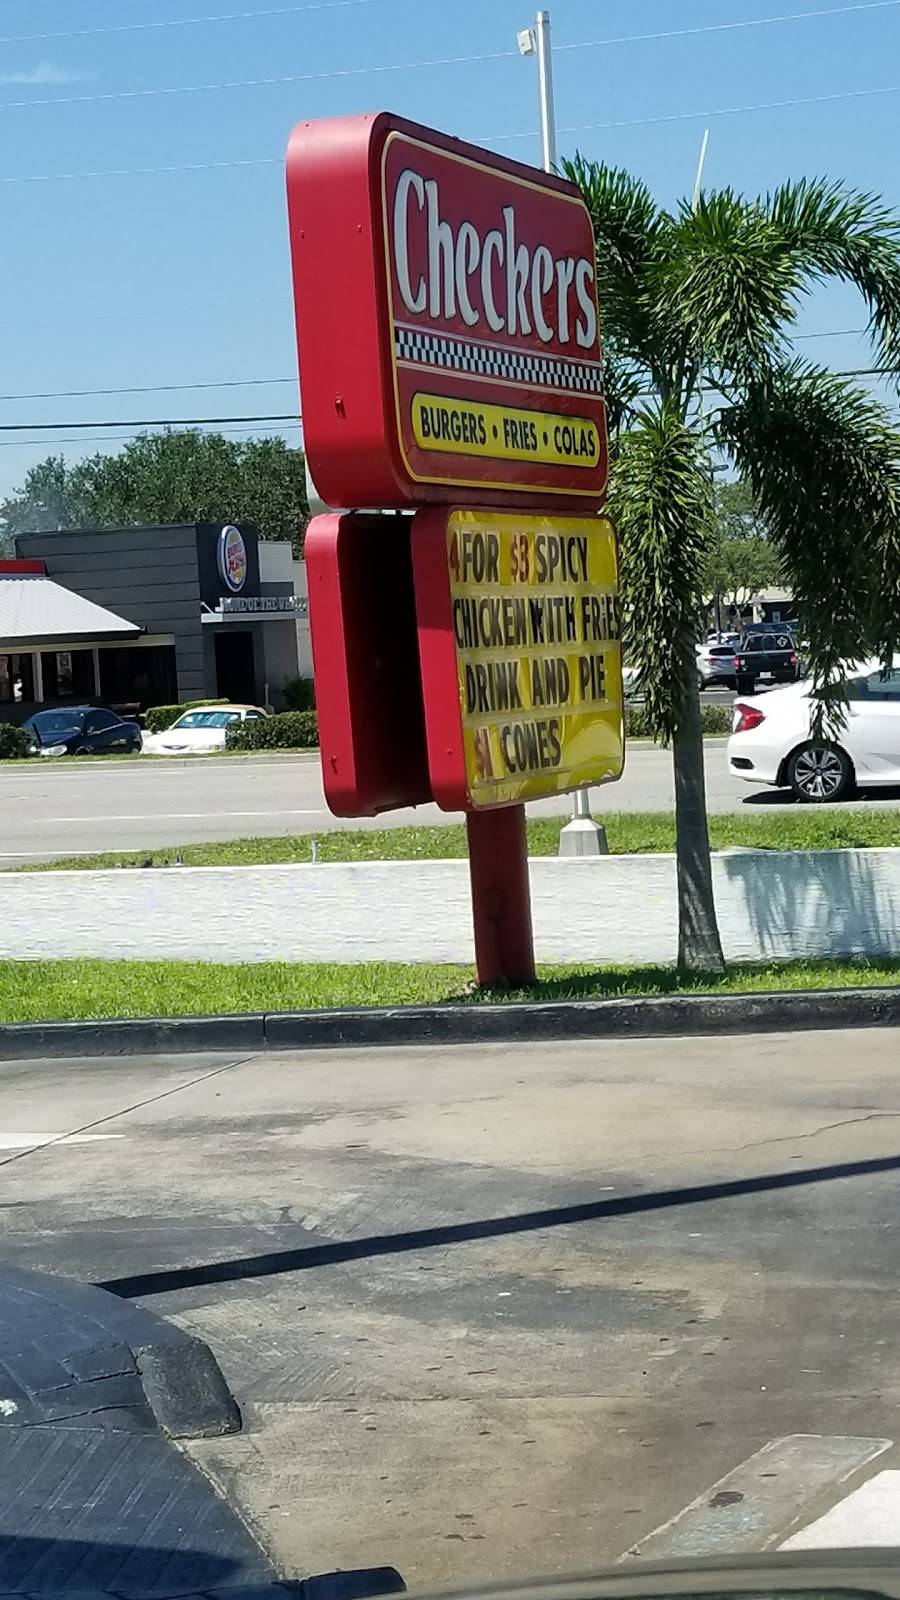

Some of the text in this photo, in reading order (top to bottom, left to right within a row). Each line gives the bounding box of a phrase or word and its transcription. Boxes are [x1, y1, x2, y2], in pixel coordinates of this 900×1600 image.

[393, 168, 597, 349] Checkers
[420, 406, 596, 457] BURGERS FRIES COLAS
[462, 532, 499, 583] FOR
[510, 534, 530, 583] $3
[537, 534, 589, 583] SPICY
[453, 596, 527, 649] CHICKEN
[529, 595, 577, 644] WITH
[465, 655, 606, 714] DRINK AND PIE
[502, 719, 562, 773] CONES
